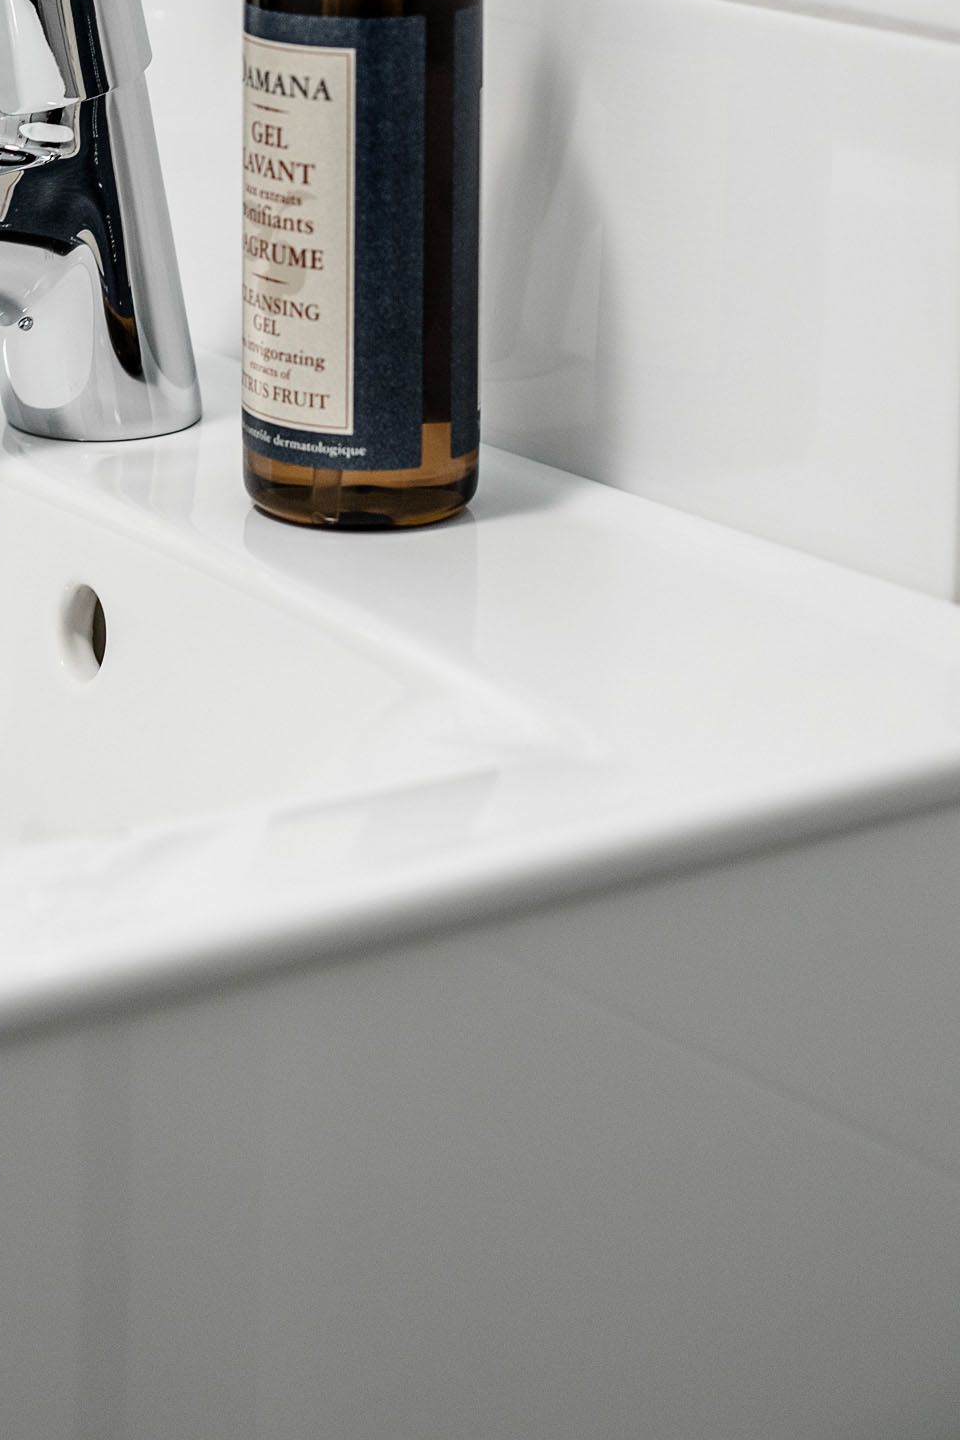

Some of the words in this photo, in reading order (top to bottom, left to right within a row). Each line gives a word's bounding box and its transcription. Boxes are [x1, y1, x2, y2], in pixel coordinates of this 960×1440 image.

[251, 120, 288, 150] GEL
[253, 313, 280, 337] GEL
[273, 385, 330, 409] FRUIT
[273, 433, 366, 458] dermatologique
